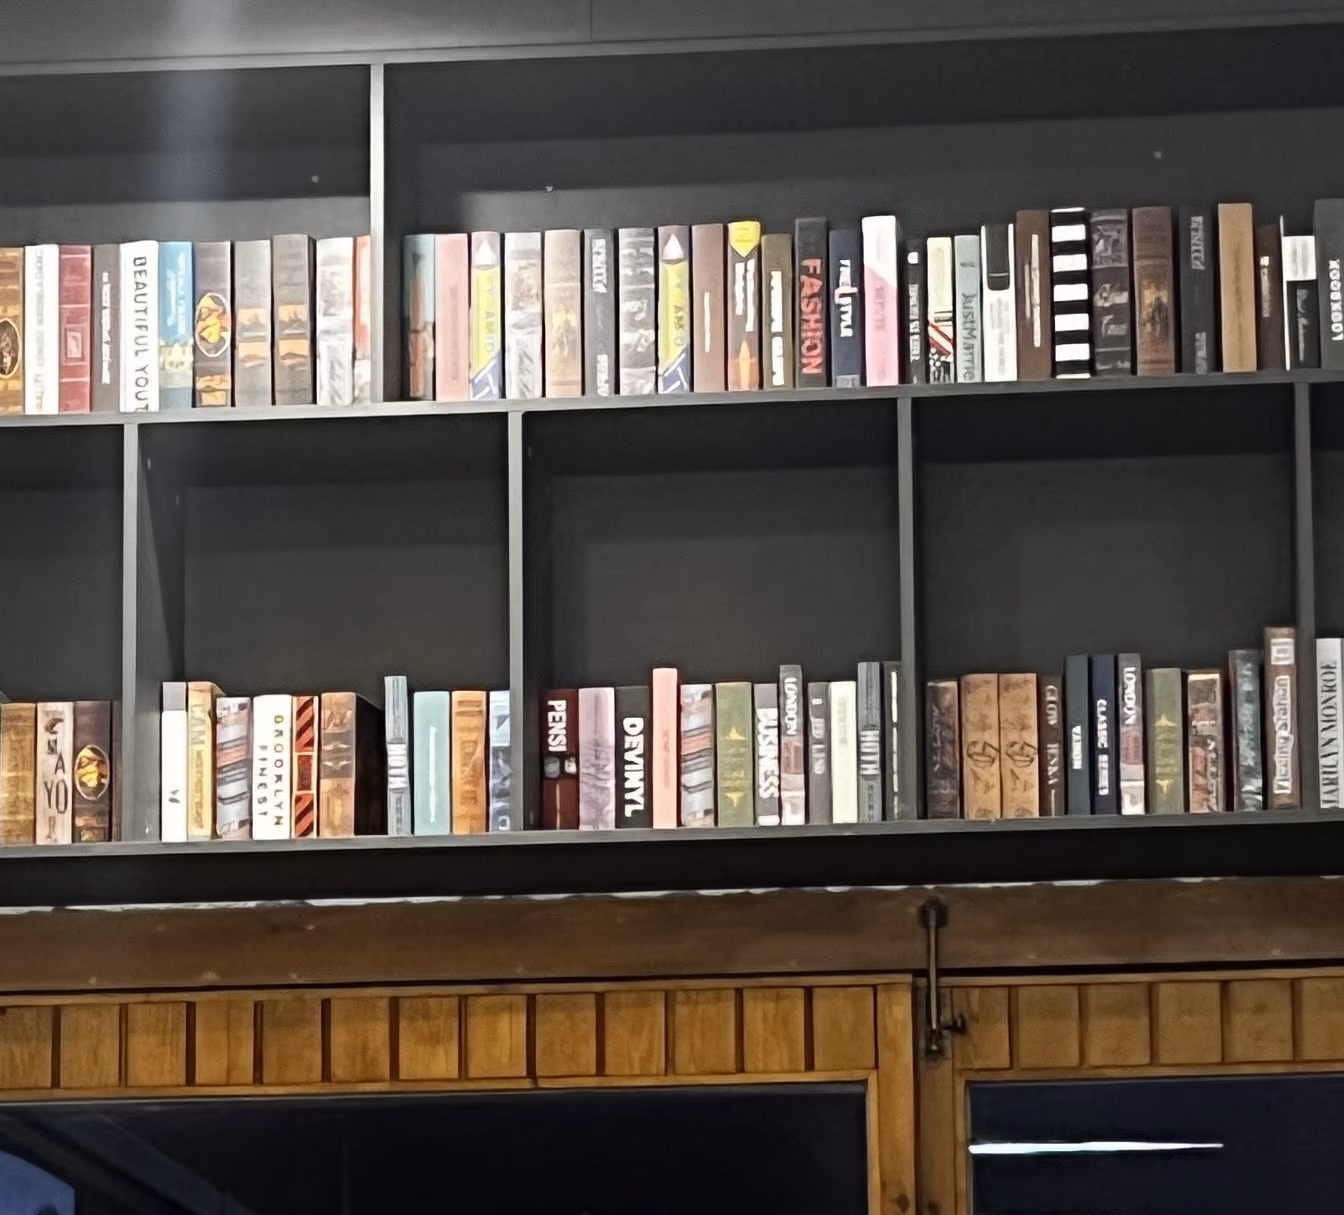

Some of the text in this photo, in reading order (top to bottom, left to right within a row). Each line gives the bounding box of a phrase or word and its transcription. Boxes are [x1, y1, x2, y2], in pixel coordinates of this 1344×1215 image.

[132, 256, 149, 358] BEAUTIFUL
[801, 258, 824, 376] FASHION
[1329, 259, 1344, 341] LOOKBOOK
[546, 699, 567, 752] PENSI
[622, 716, 645, 818] DEVINYL
